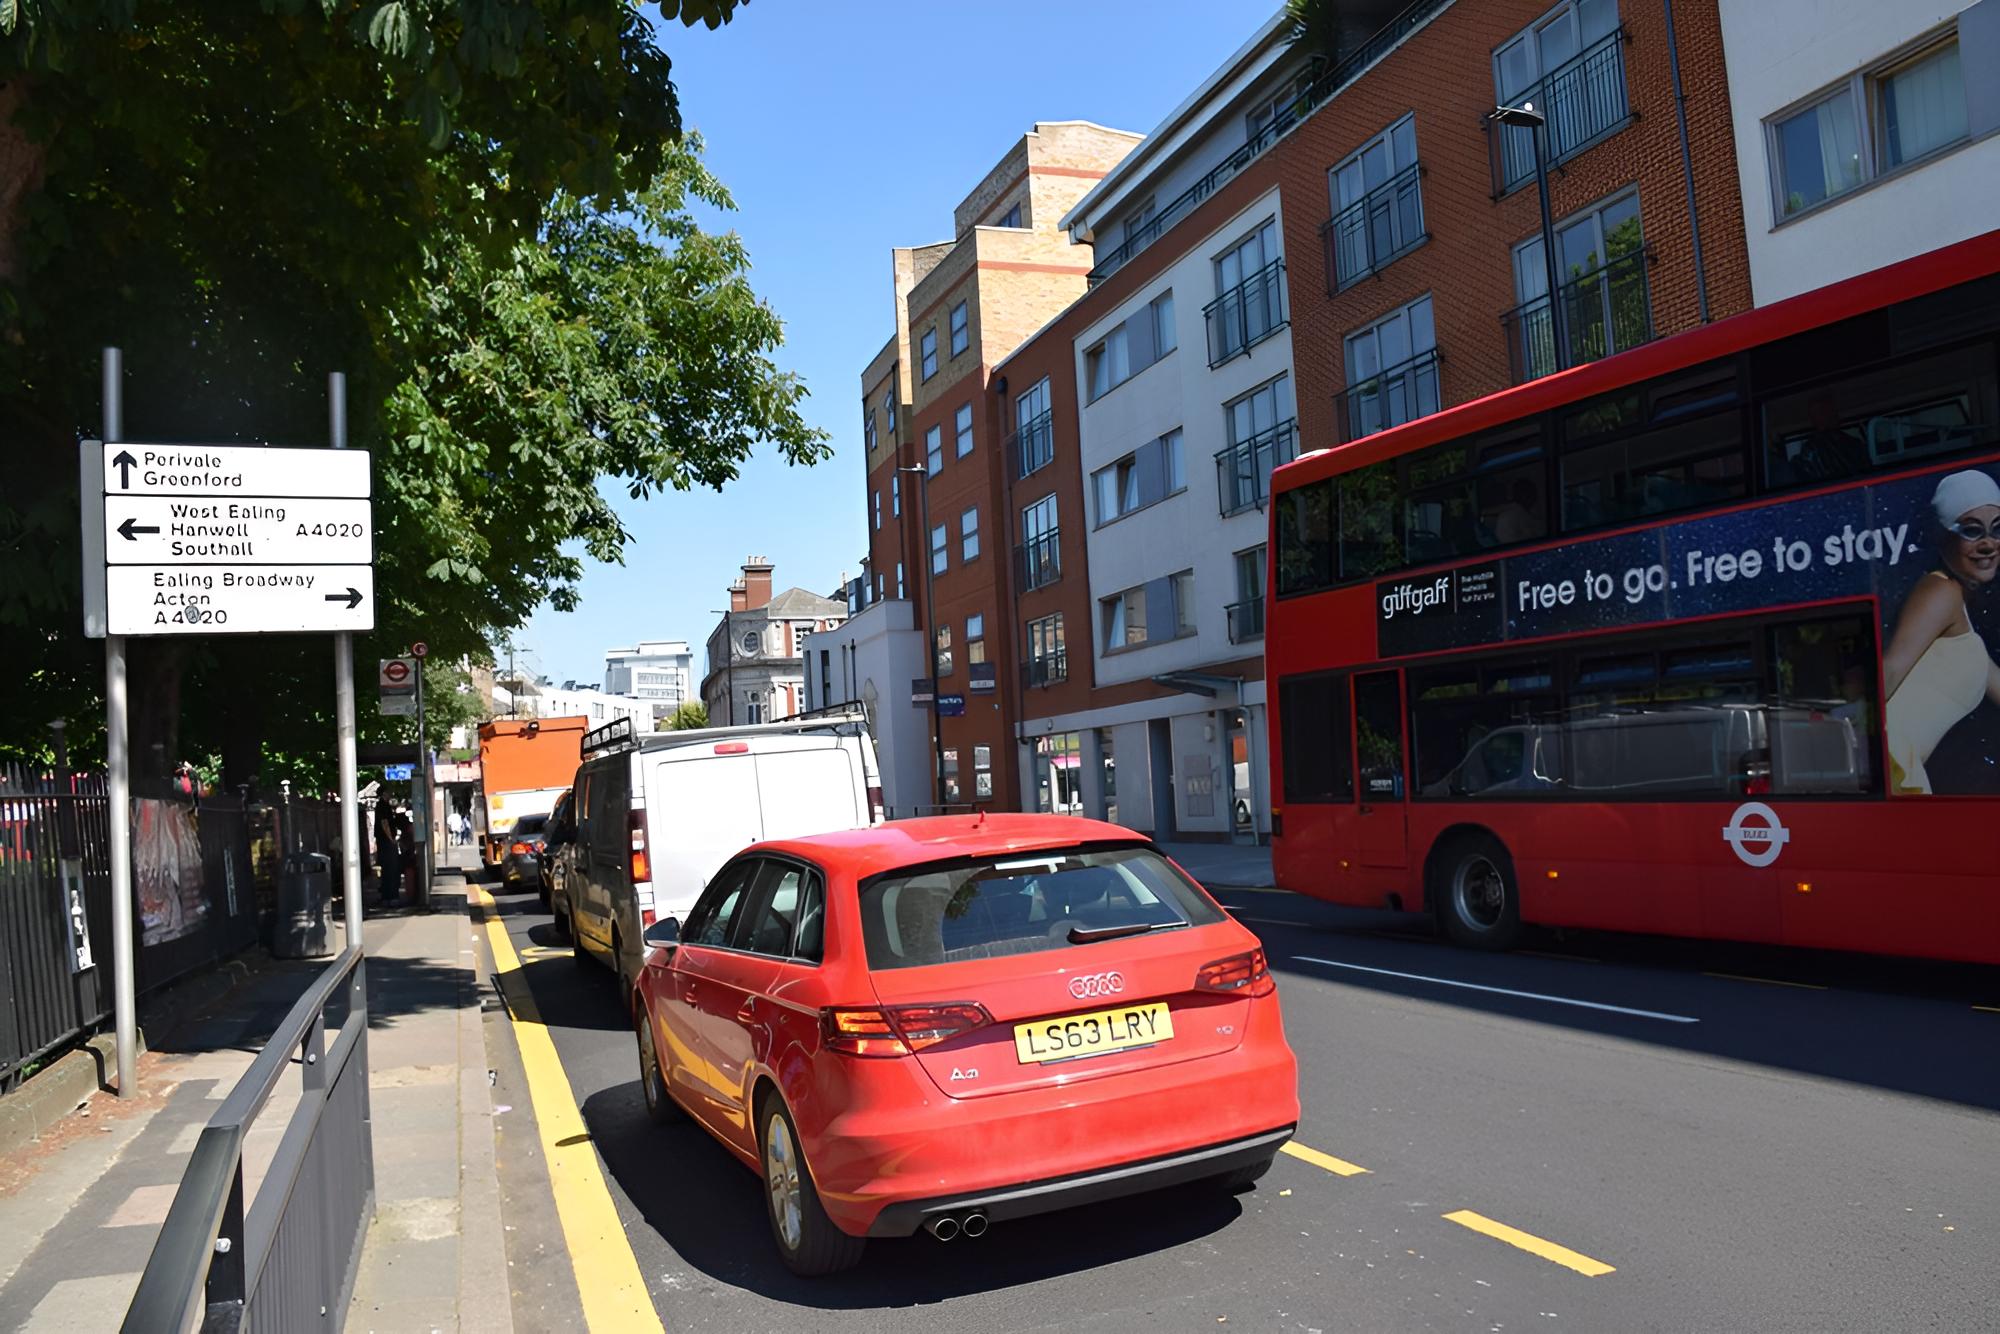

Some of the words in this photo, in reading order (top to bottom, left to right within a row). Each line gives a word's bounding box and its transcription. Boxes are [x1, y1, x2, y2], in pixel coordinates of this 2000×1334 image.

[229, 504, 286, 521] Ealing
[295, 523, 364, 538] A4020
[171, 541, 254, 557] Southall
[1518, 579, 1576, 612] Free
[1583, 569, 1614, 602] to
[1622, 564, 1678, 603] go.
[1687, 548, 1763, 587] Free
[1772, 536, 1813, 573] to
[1823, 522, 1919, 566] stay.
[153, 572, 213, 589] Ealing
[223, 572, 315, 589] Broadway
[153, 592, 211, 606] Acton
[1382, 576, 1449, 620] giffgaff
[154, 609, 228, 625] A420
[1027, 1018, 1101, 1055] LS63
[1107, 1008, 1158, 1043] LRY
